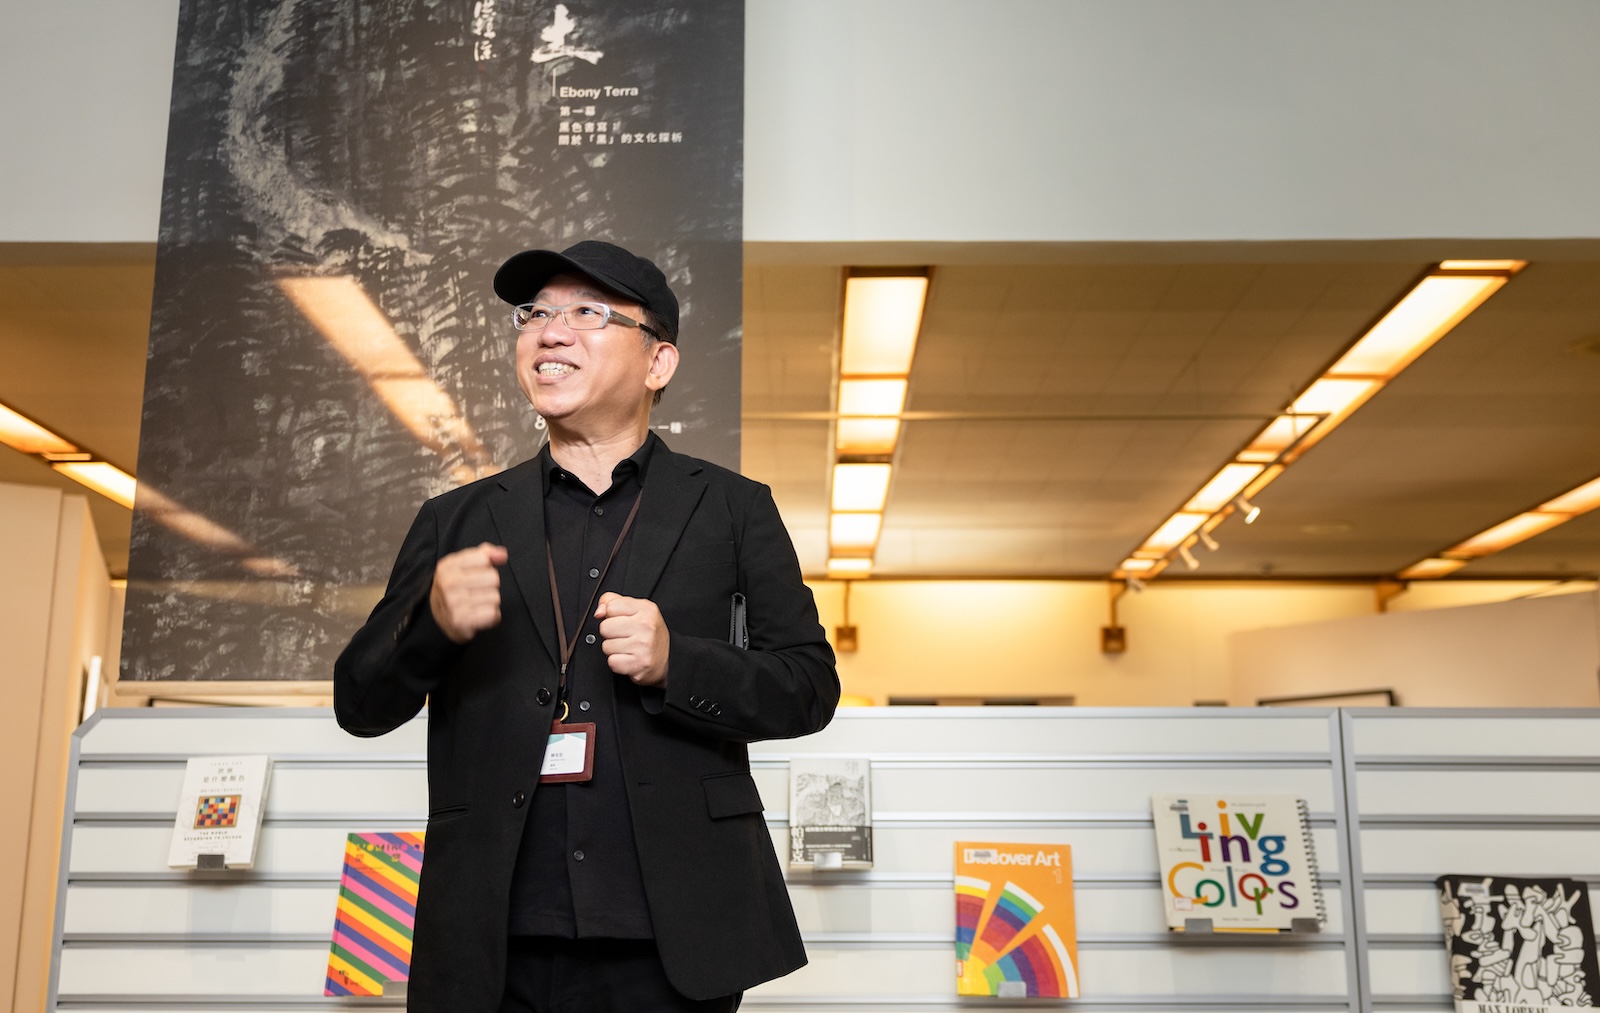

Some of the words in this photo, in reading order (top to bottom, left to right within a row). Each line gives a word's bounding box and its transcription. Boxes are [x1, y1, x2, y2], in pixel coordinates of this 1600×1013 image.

[560, 86, 601, 99] Ebony
[604, 85, 639, 97] Terra
[1034, 851, 1061, 867] Art
[1168, 861, 1300, 916] Colors
